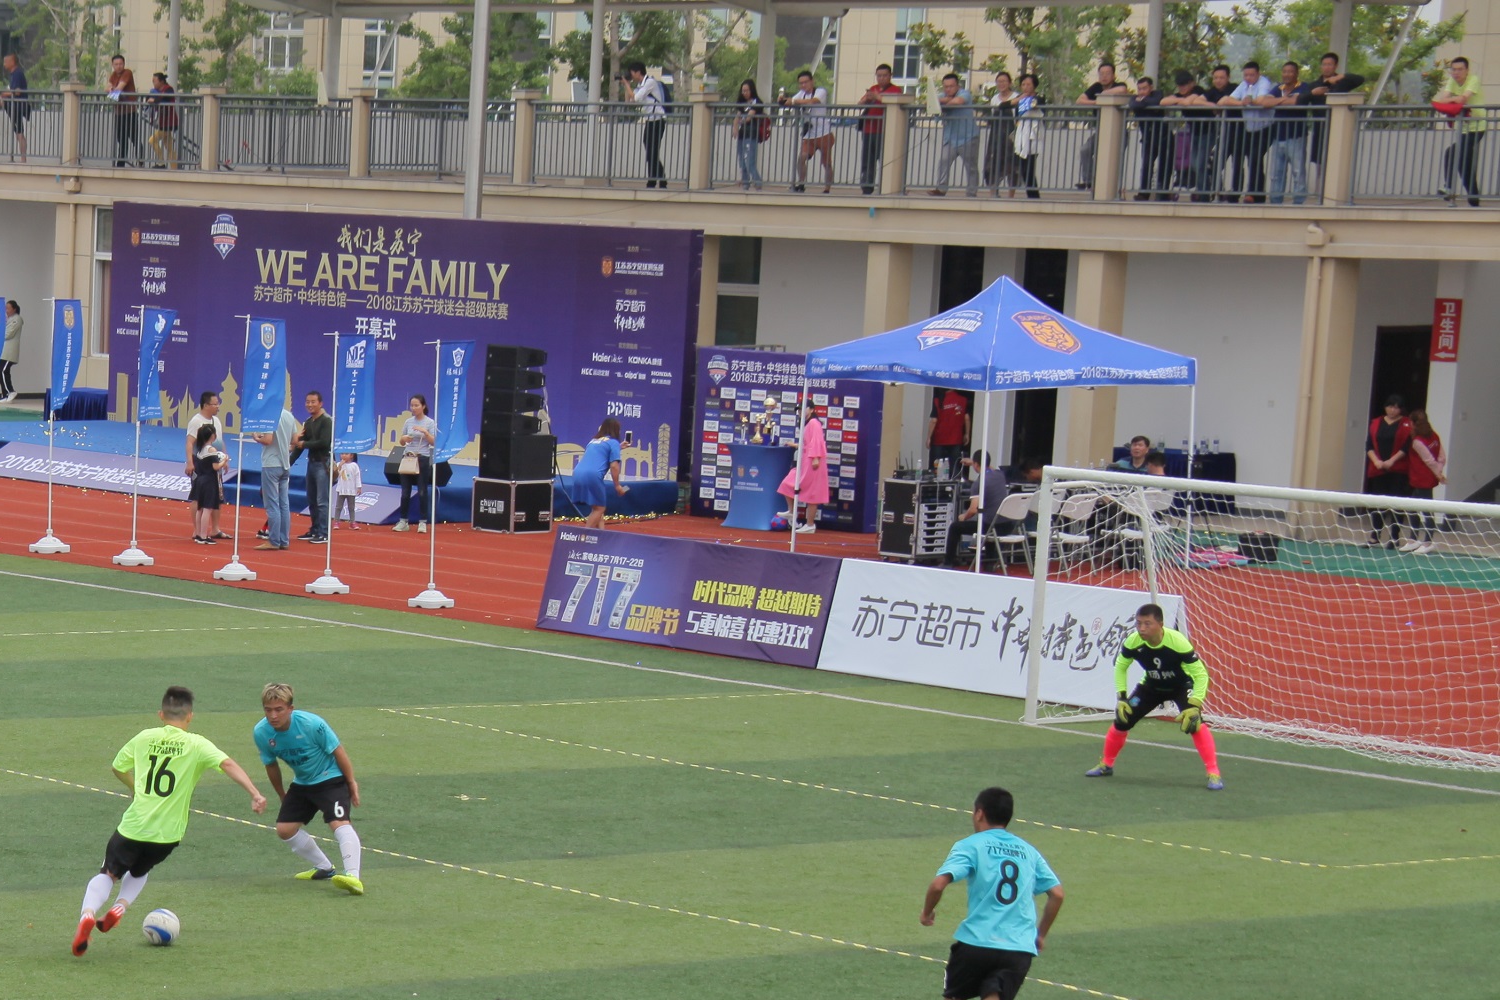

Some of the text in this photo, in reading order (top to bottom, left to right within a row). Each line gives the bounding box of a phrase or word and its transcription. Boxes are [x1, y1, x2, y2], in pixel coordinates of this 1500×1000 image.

[337, 224, 422, 257] 我们是苏宁
[142, 266, 166, 278] 苏宁超市
[255, 248, 510, 300] WE ARE FAMILY
[615, 299, 646, 313] 苏宁超市
[355, 317, 397, 341] 开幕式
[1439, 302, 1456, 350] 卫生间
[592, 352, 611, 363] Haier
[560, 531, 578, 542] Haier
[561, 560, 680, 636] 717 品牌节
[692, 580, 823, 618] 时代品牌 超越期待
[684, 610, 814, 650] 5重惊喜 钜惠狂欢
[851, 595, 985, 651] 苏宁超市
[1153, 657, 1161, 669] 9
[144, 755, 176, 797] 16
[334, 800, 345, 818] 6
[996, 860, 1019, 905] 8
